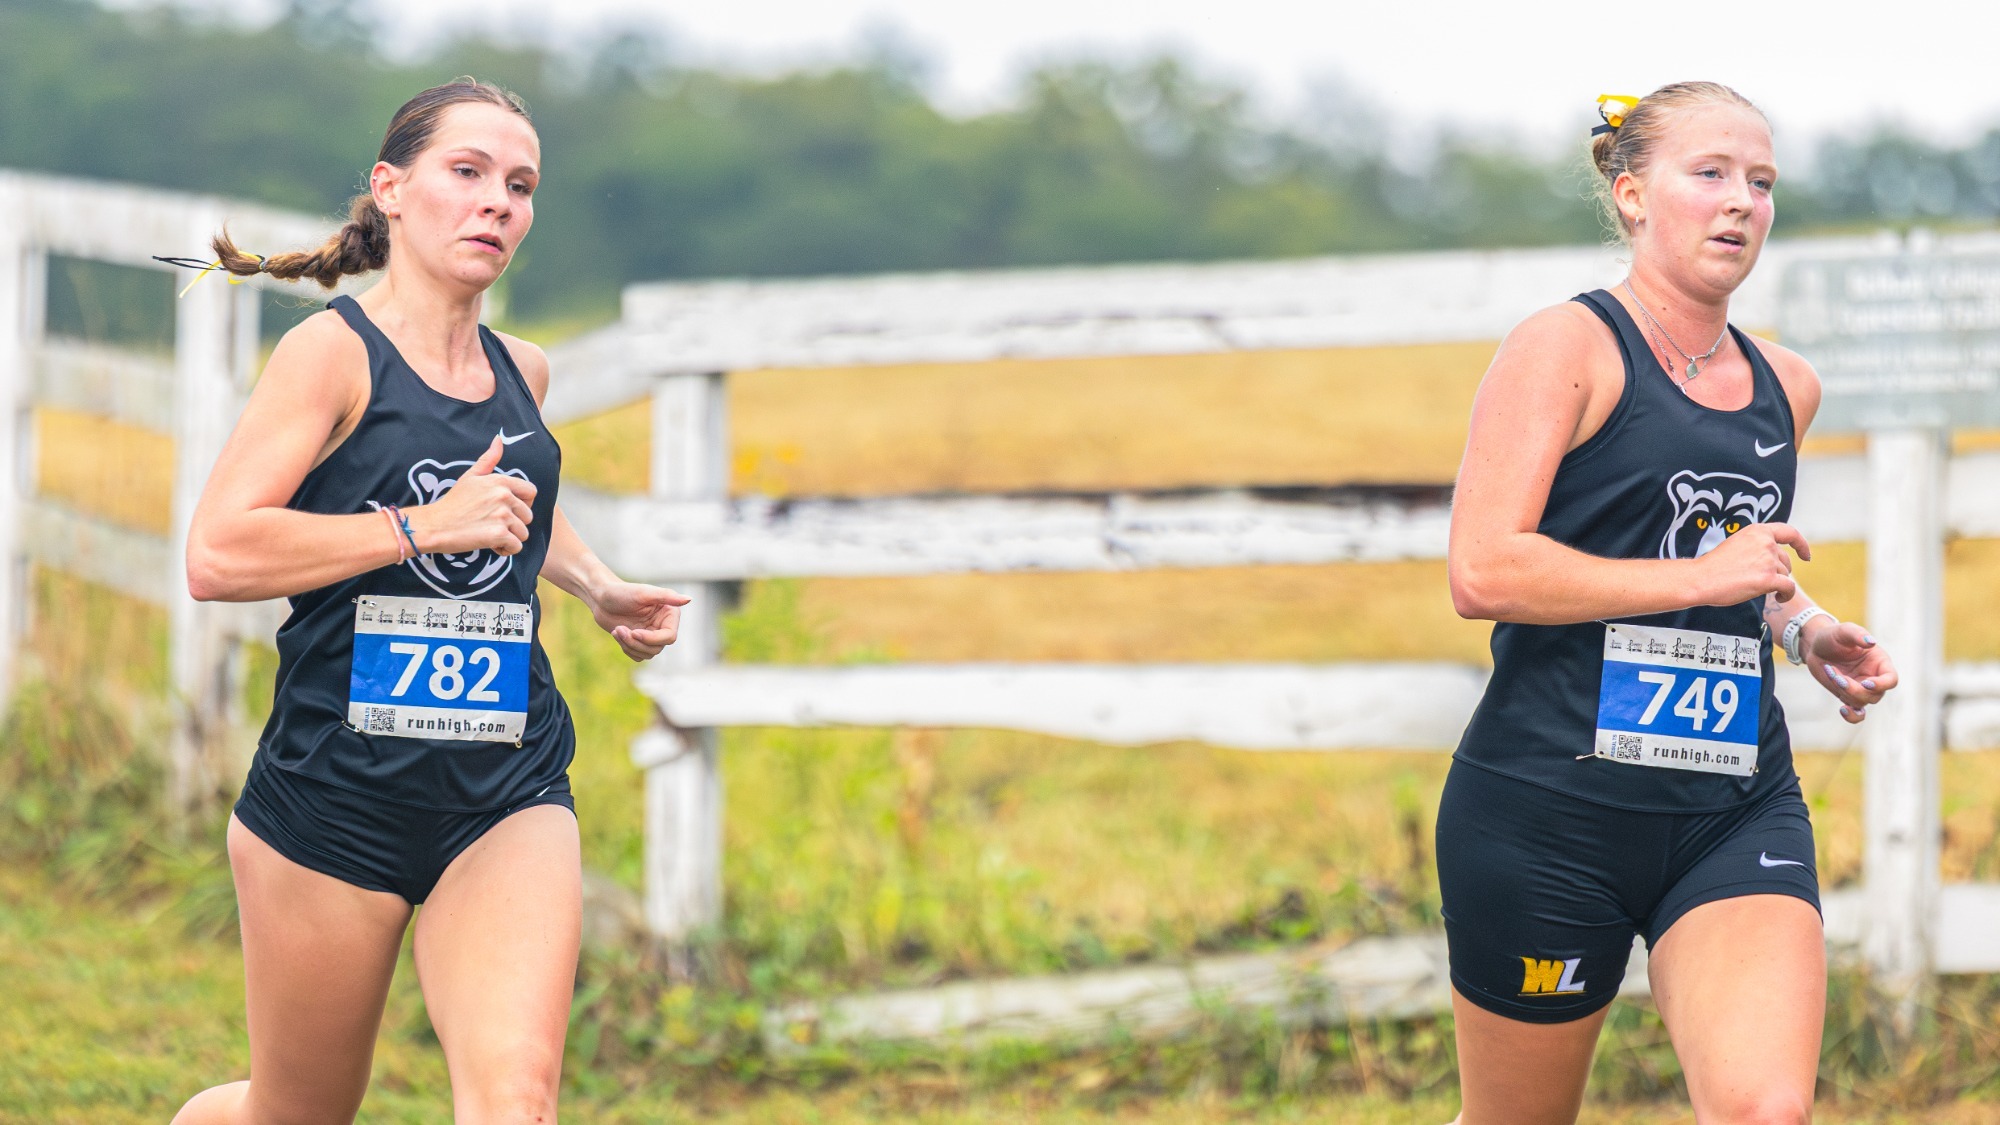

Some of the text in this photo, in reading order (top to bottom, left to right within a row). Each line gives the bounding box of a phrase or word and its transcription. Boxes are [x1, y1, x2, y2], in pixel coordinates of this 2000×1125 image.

[456, 604, 487, 621] RUNNER'S
[494, 604, 525, 622] RUNNER'S
[507, 621, 524, 629] HIGH
[390, 642, 500, 703] 782
[1638, 671, 1739, 734] 749
[407, 717, 506, 734] runhigh.com
[1653, 746, 1740, 766] runhigh.com
[1519, 956, 1586, 993] WL
